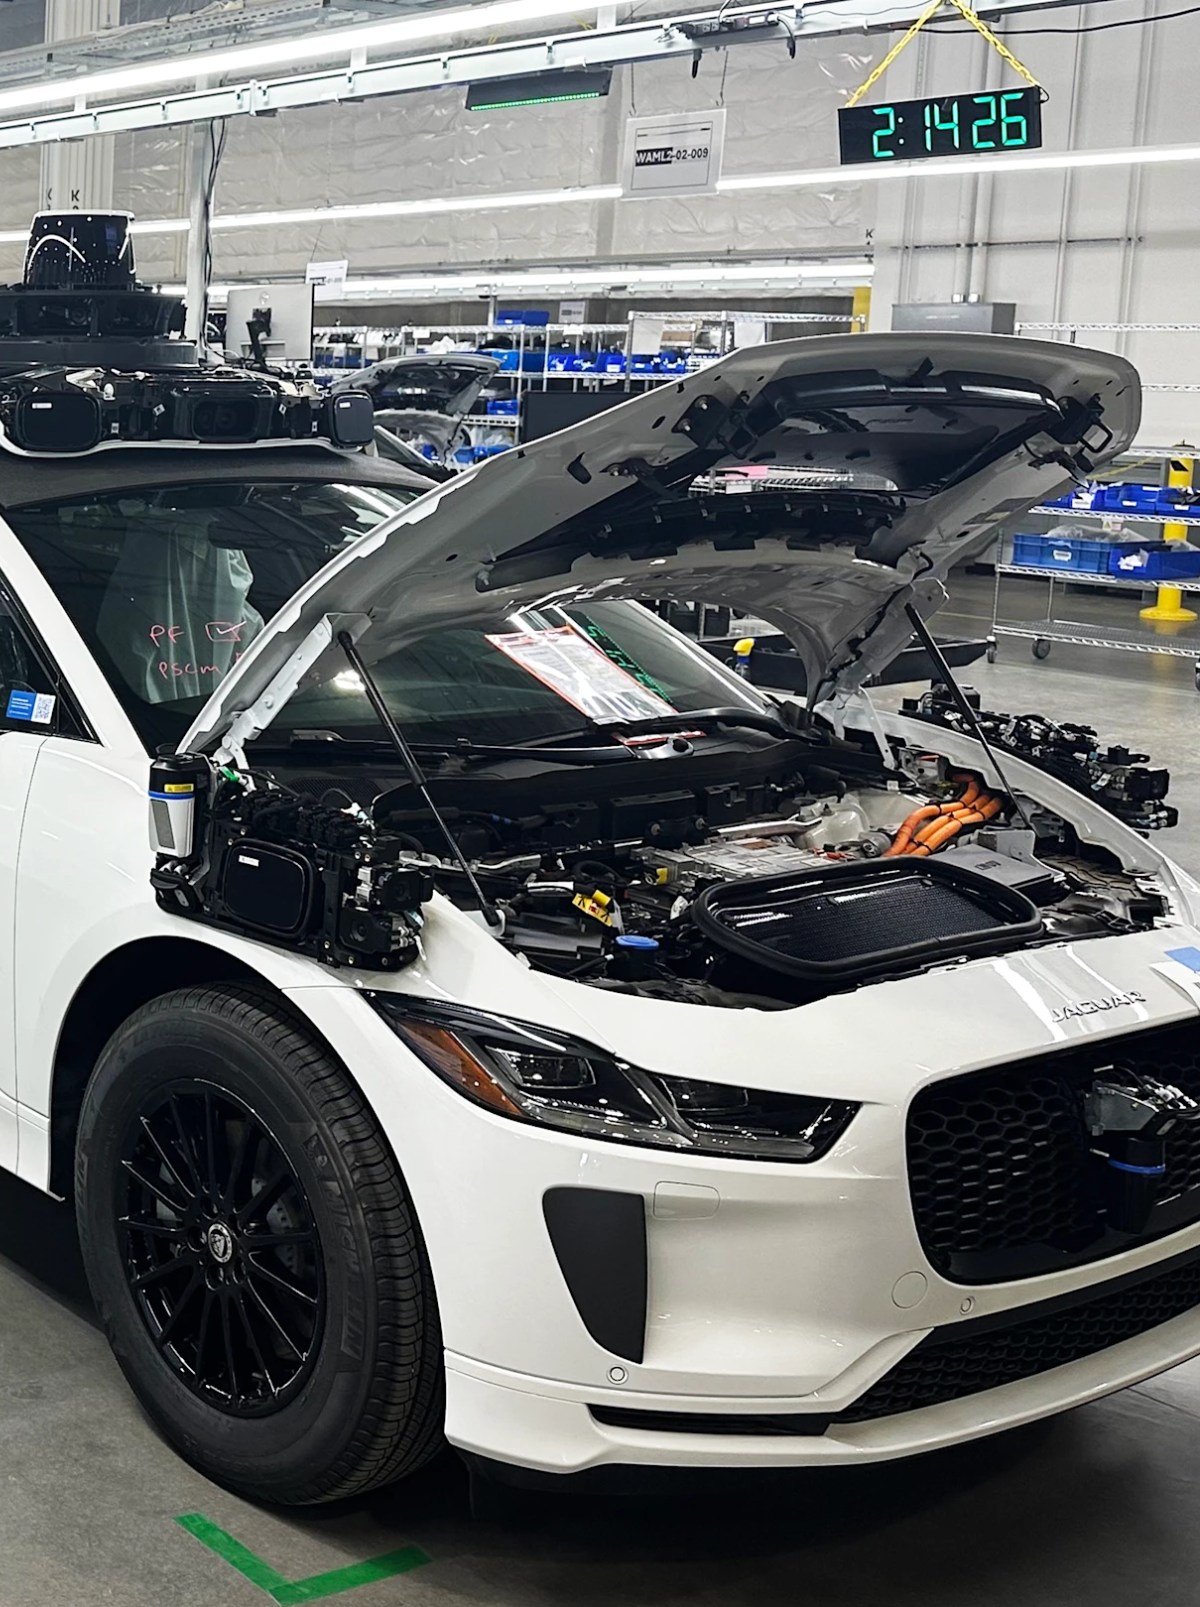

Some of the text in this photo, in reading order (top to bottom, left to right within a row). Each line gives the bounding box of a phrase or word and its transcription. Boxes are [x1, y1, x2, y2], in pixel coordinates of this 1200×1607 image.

[972, 92, 1027, 149] 26
[71, 189, 80, 201] K
[150, 625, 184, 647] PF
[1052, 991, 1146, 1023] JAGUAR
